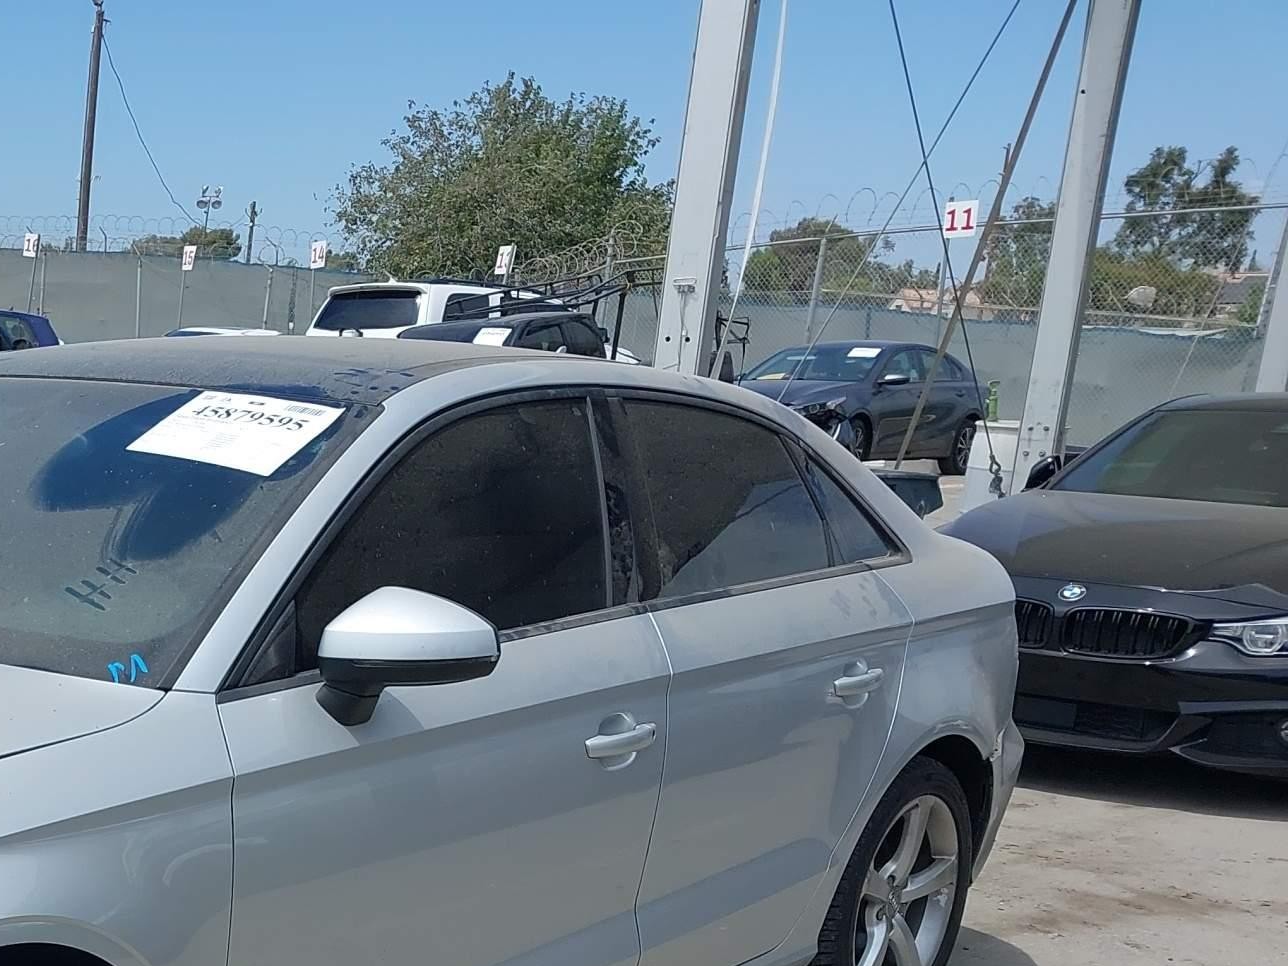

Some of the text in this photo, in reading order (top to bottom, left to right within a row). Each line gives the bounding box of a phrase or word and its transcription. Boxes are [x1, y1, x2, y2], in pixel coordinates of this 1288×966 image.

[945, 207, 974, 231] 11
[183, 250, 194, 266] 15
[311, 246, 325, 263] 14
[192, 404, 311, 431] 45879595
